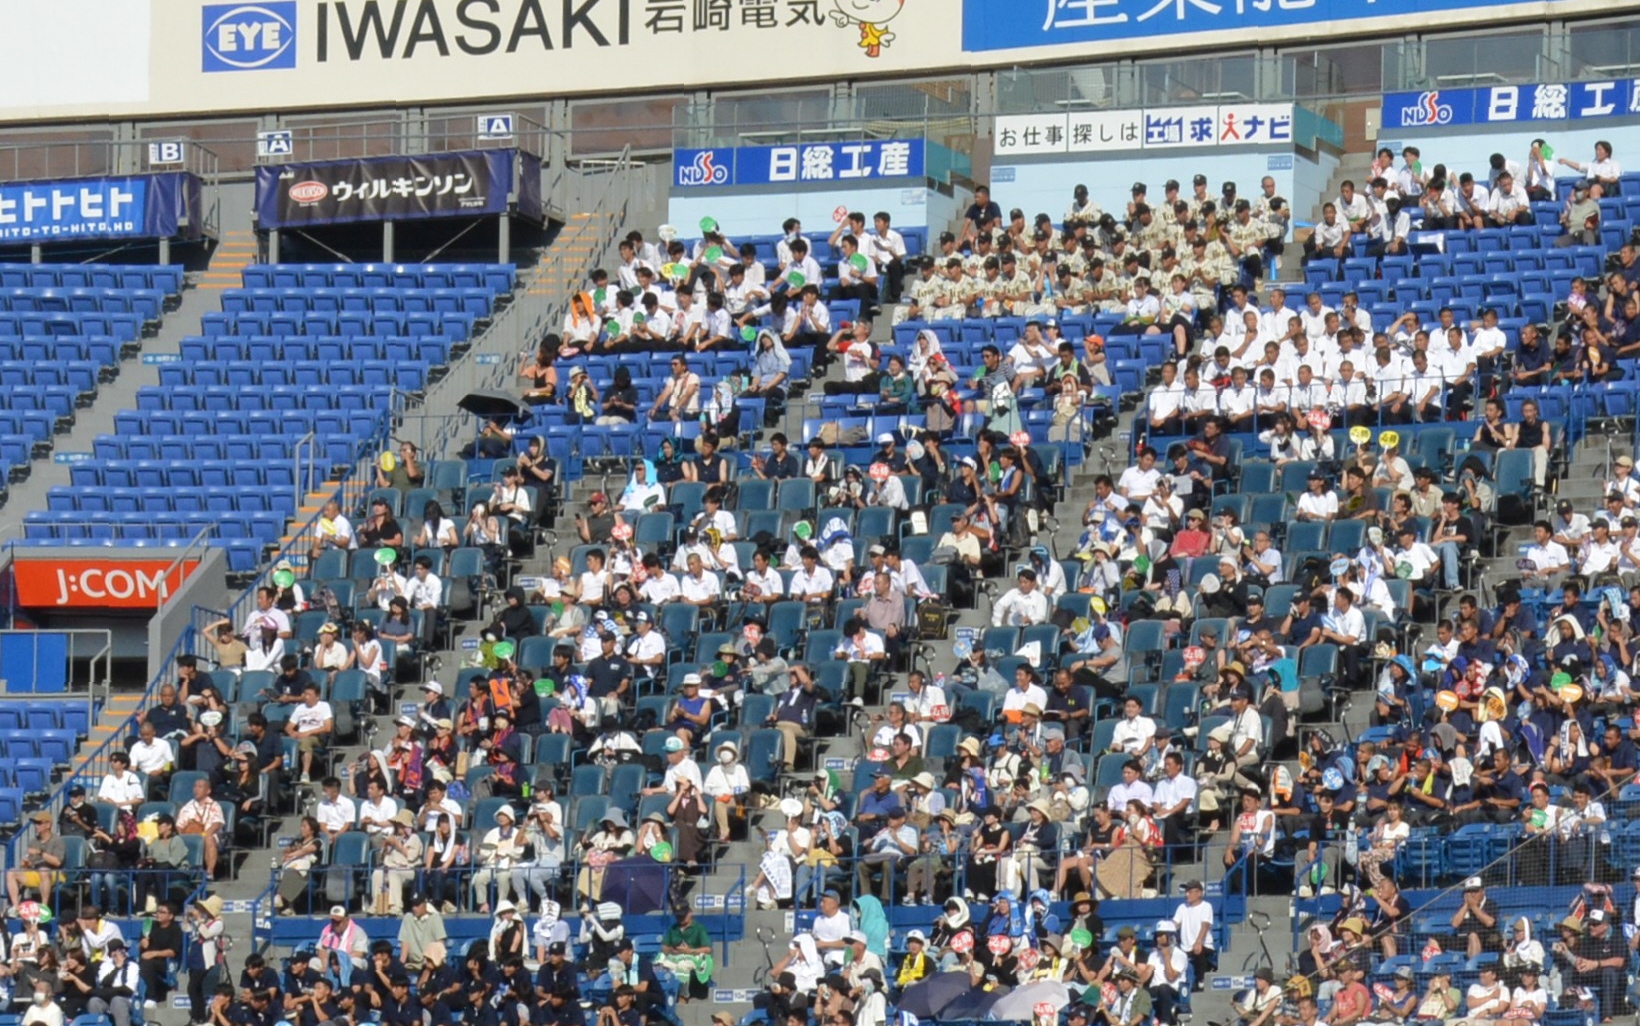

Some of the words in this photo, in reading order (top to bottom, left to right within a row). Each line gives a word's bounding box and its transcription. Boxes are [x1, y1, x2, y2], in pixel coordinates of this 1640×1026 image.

[317, 0, 629, 62] IWASAKI
[645, 0, 827, 34] 岩崎電気
[218, 22, 281, 52] EYE
[1402, 91, 1452, 126] NISSO
[1000, 120, 1139, 147] お仕事探しは
[161, 142, 179, 160] B
[769, 142, 910, 181] 日総工産
[680, 152, 727, 184] NISSO
[332, 173, 473, 201] ウィルキンソン
[56, 569, 168, 604] J:COM
